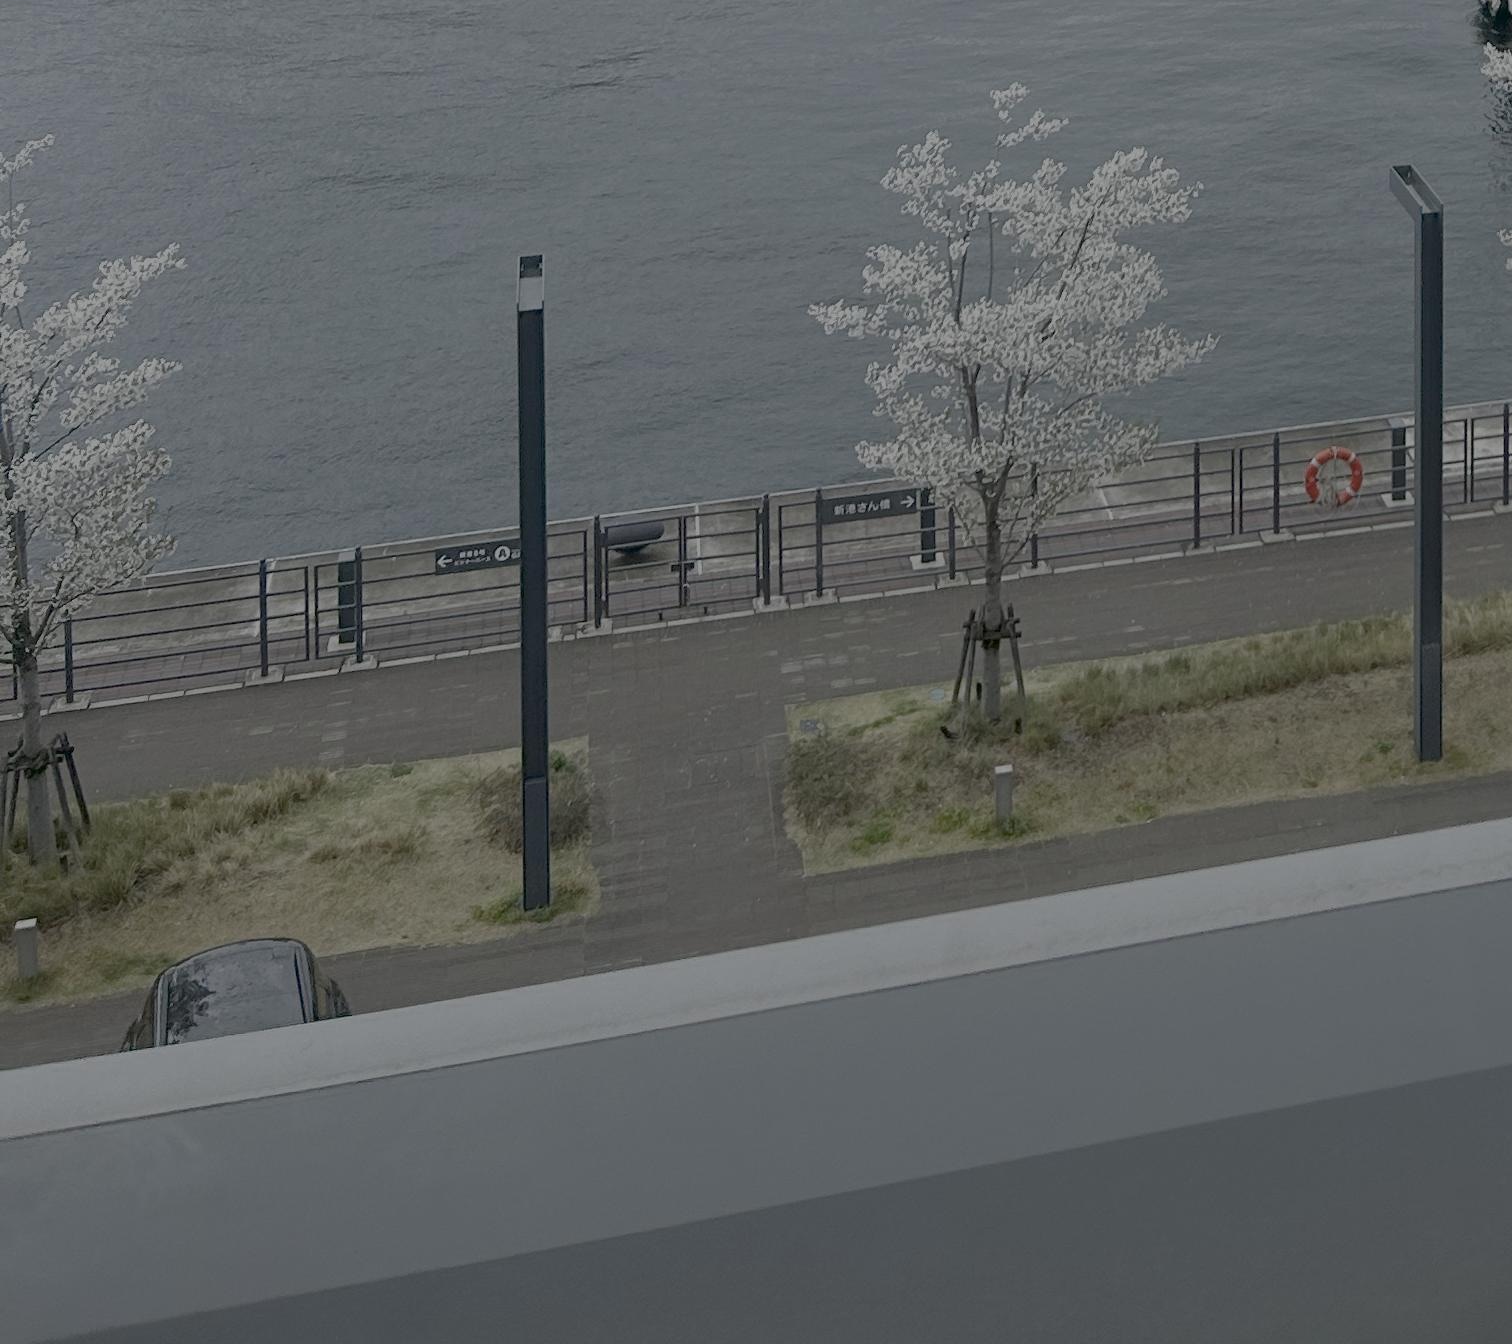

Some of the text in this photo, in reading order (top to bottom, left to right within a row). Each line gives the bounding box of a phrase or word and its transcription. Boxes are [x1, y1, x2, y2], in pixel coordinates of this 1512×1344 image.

[833, 498, 892, 516] 新港さん橋
